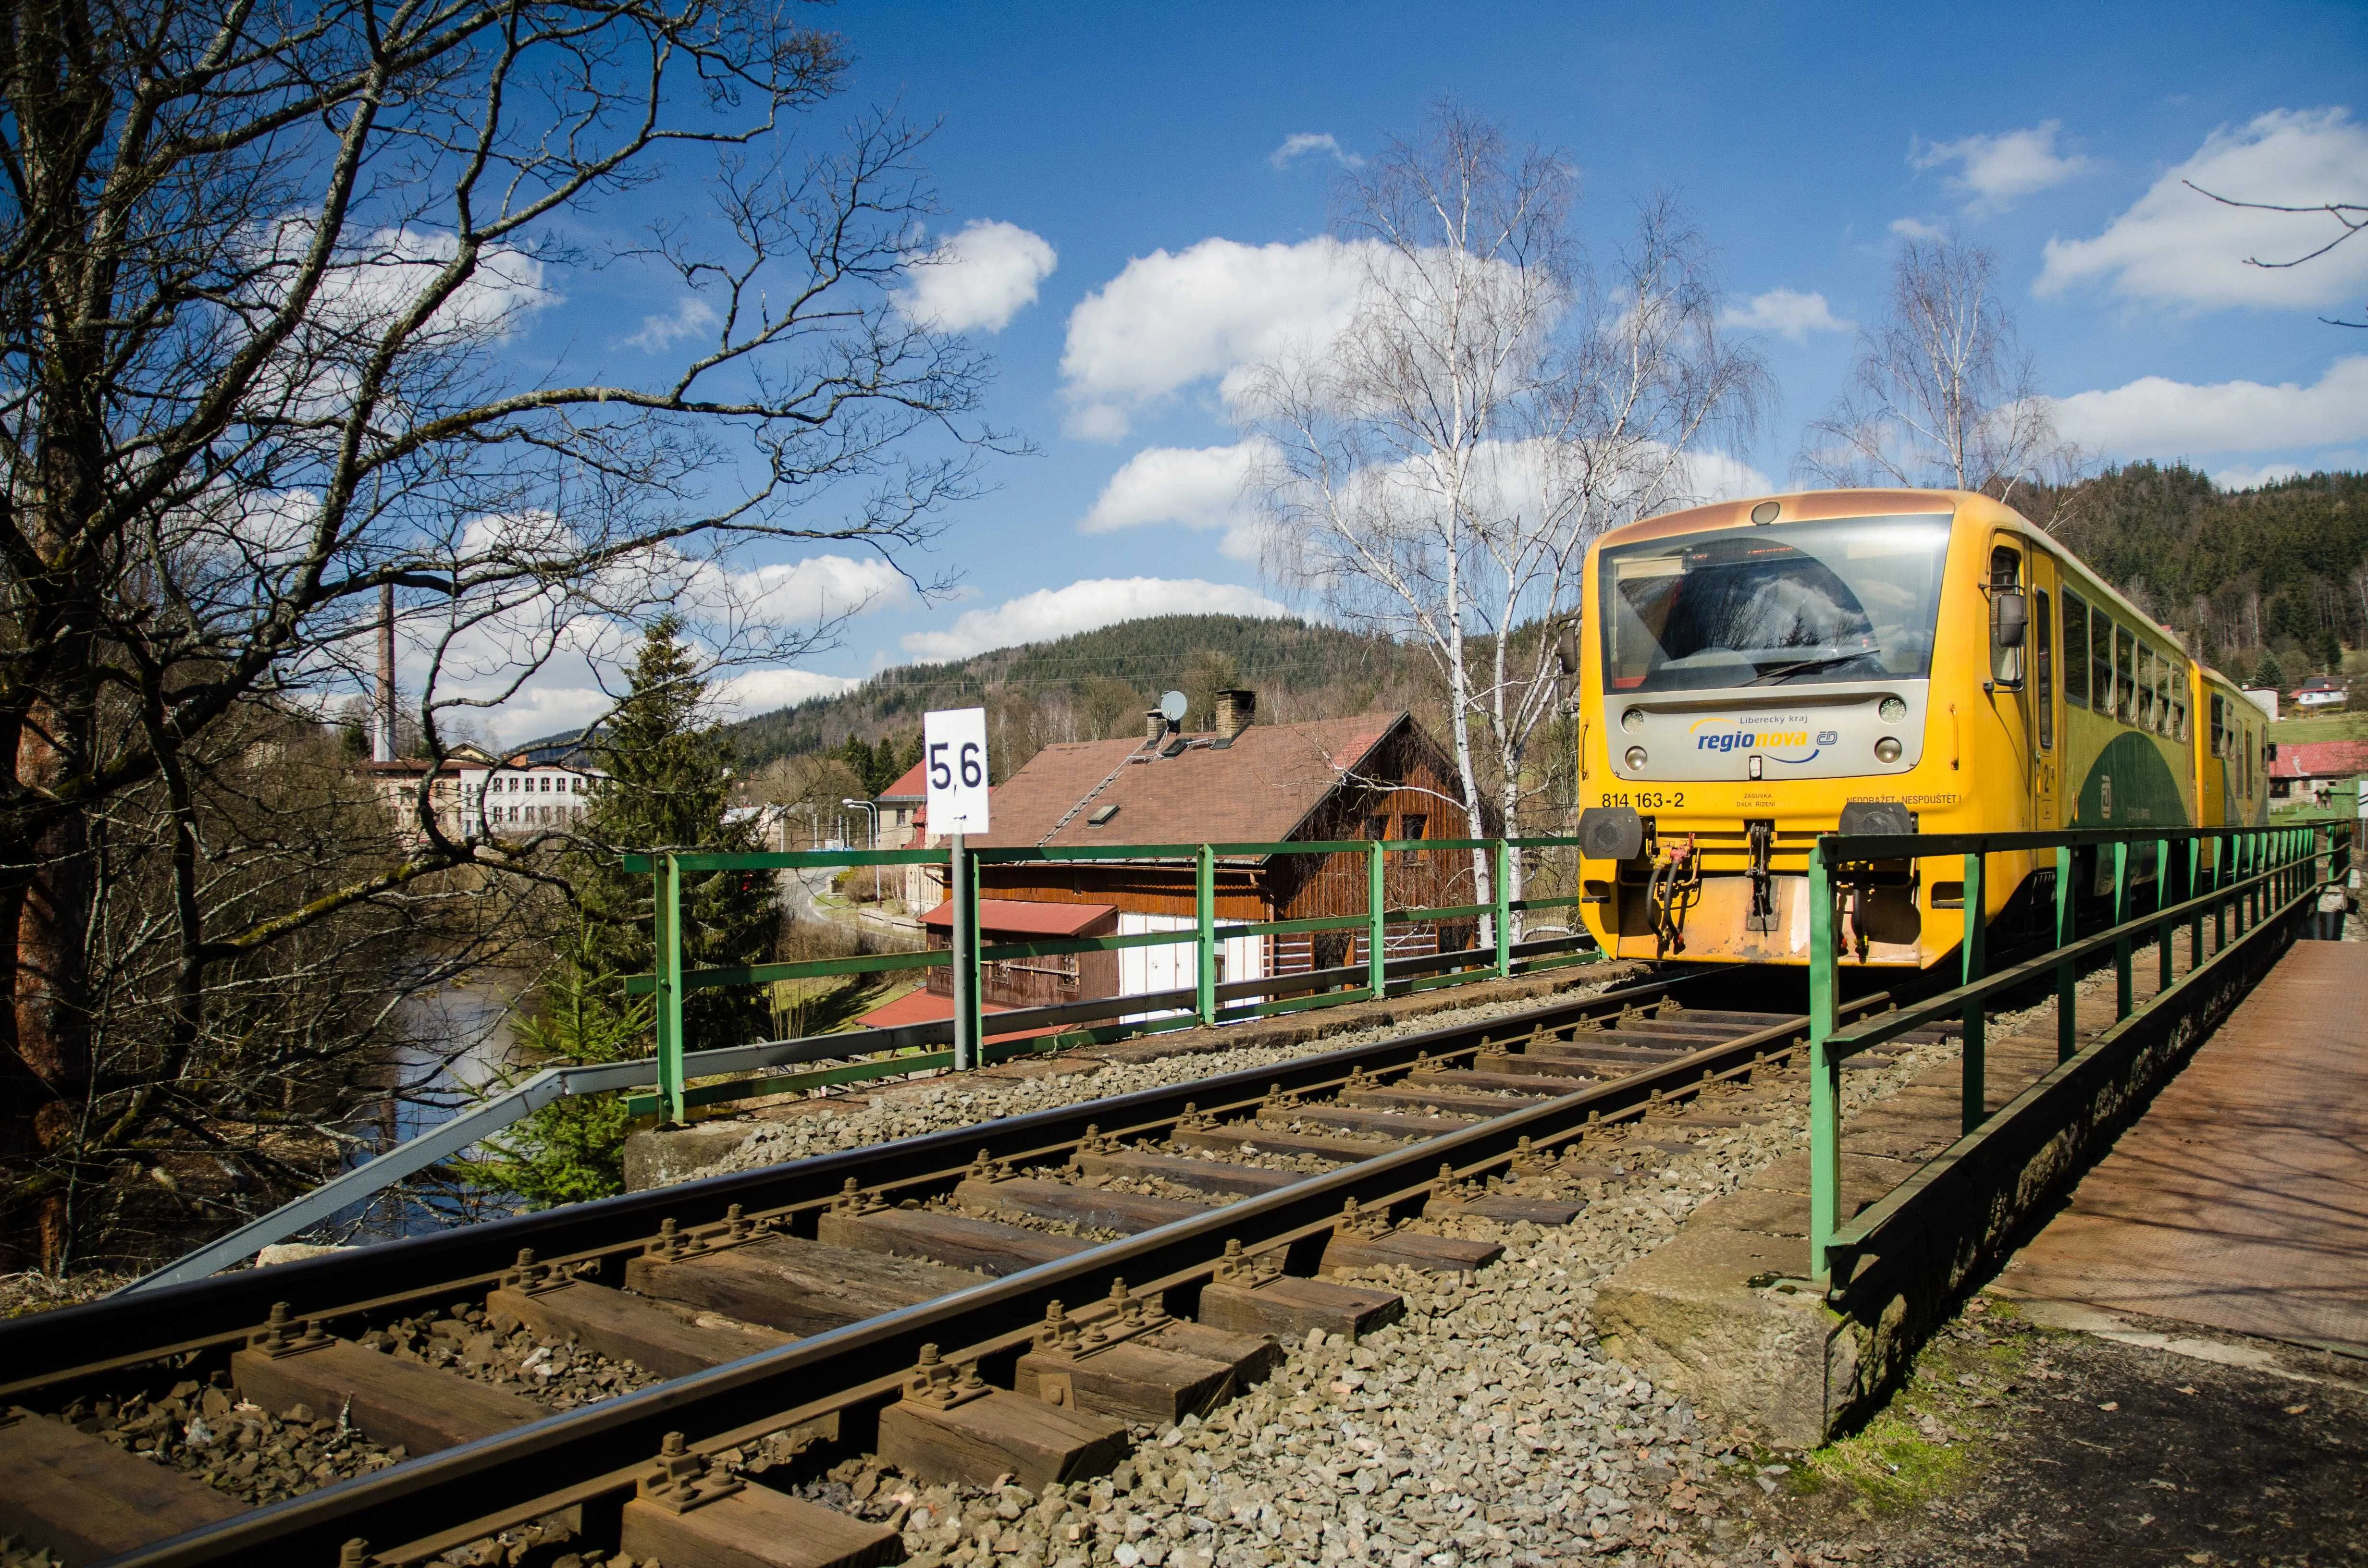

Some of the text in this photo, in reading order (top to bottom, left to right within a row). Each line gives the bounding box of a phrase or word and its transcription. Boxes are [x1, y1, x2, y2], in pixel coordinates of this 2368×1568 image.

[1739, 715, 1807, 724] Liberecký kraj
[1698, 731, 1807, 752] regionova
[929, 742, 981, 796] 5,6
[1602, 793, 1628, 808] 814
